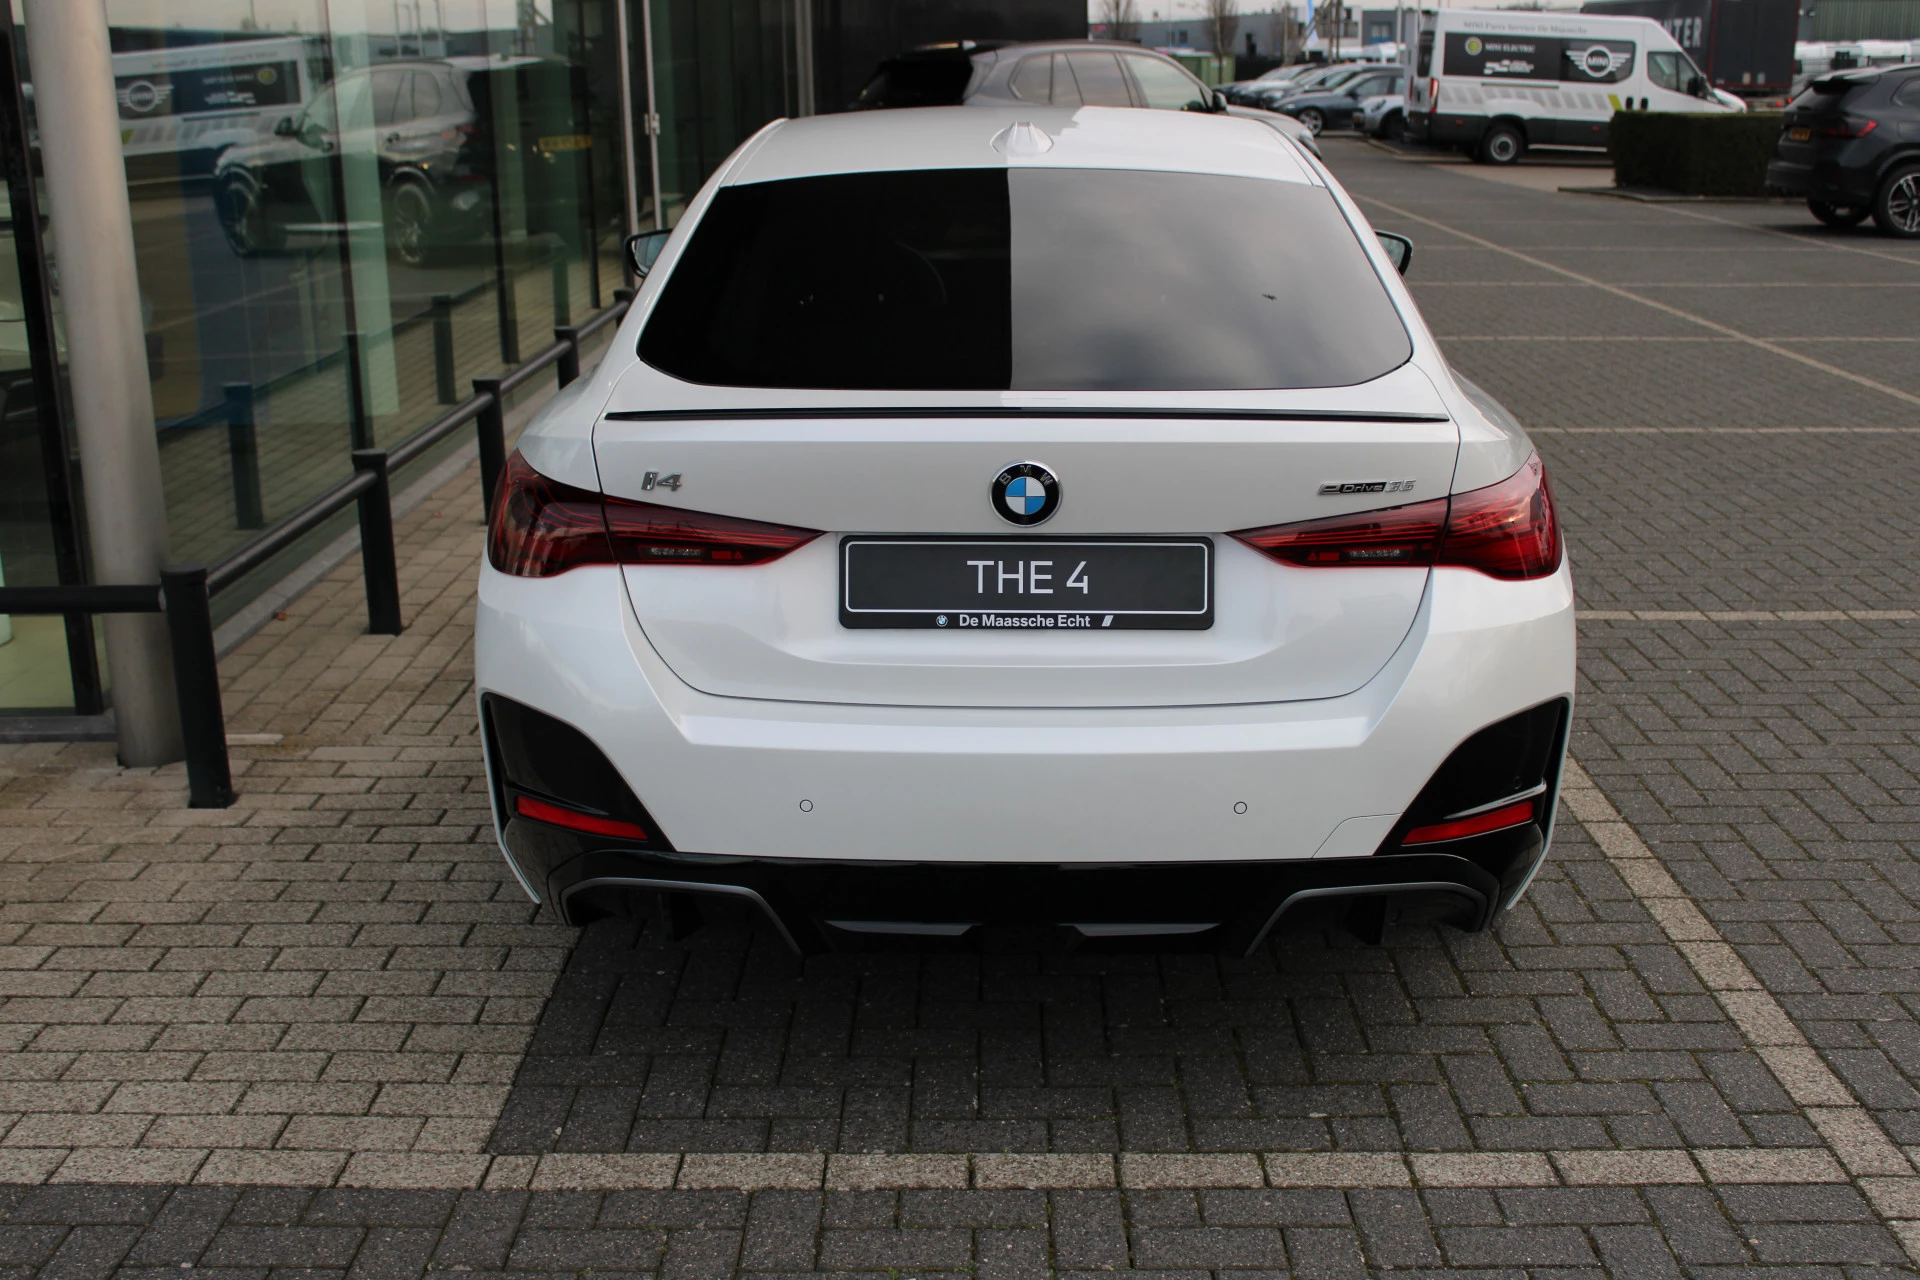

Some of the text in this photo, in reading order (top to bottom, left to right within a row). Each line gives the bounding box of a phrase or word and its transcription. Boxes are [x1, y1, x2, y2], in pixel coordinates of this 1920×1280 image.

[1587, 55, 1609, 66] MINI
[999, 464, 1053, 486] BMW
[967, 560, 1089, 594] THE 4
[959, 614, 1090, 627] De Maassche Echt
